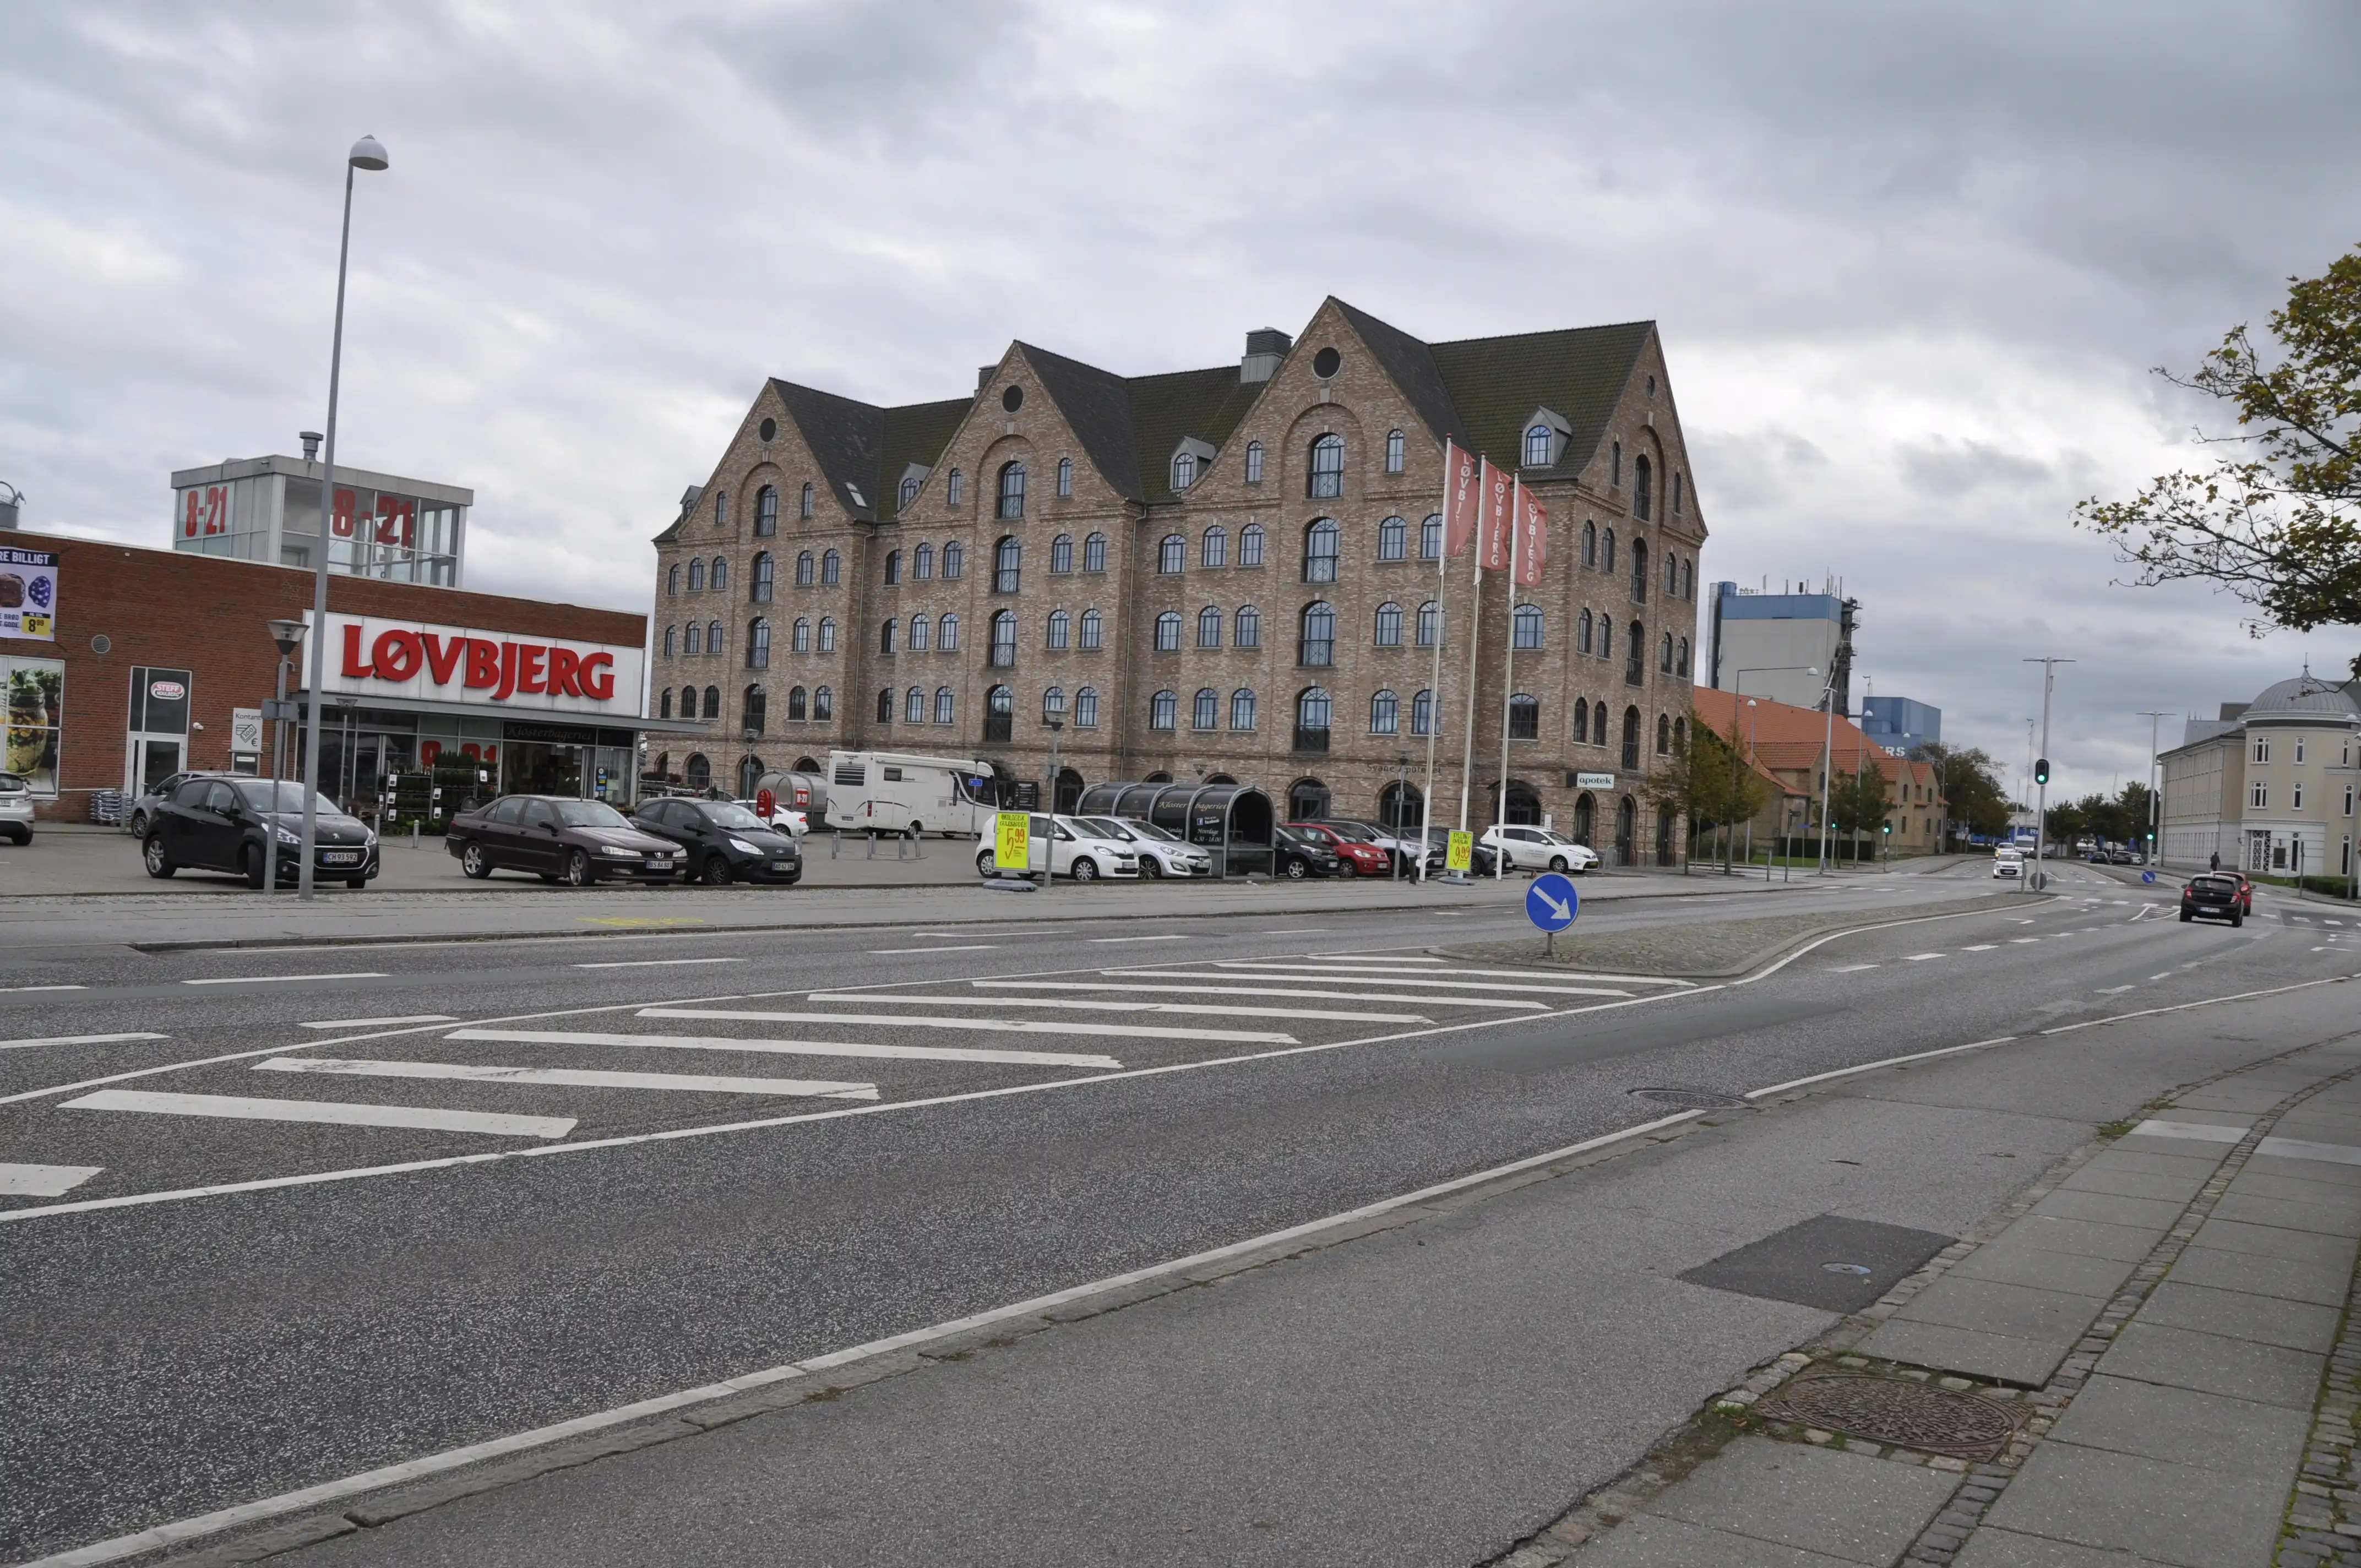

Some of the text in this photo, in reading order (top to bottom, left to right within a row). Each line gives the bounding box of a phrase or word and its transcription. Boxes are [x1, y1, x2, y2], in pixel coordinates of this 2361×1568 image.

[185, 486, 227, 537] 8-21
[1455, 453, 1471, 525] LØVBJ
[332, 488, 413, 547] 8-21
[1490, 471, 1505, 566] LØVBJERG
[1526, 499, 1538, 581] ØVBJERG
[12, 552, 50, 565] BILLIGT
[156, 684, 179, 692] STEFF
[341, 624, 615, 700] LØVBJERG
[1158, 801, 1227, 812] Kloster bageriet
[1579, 777, 1612, 785] apotek
